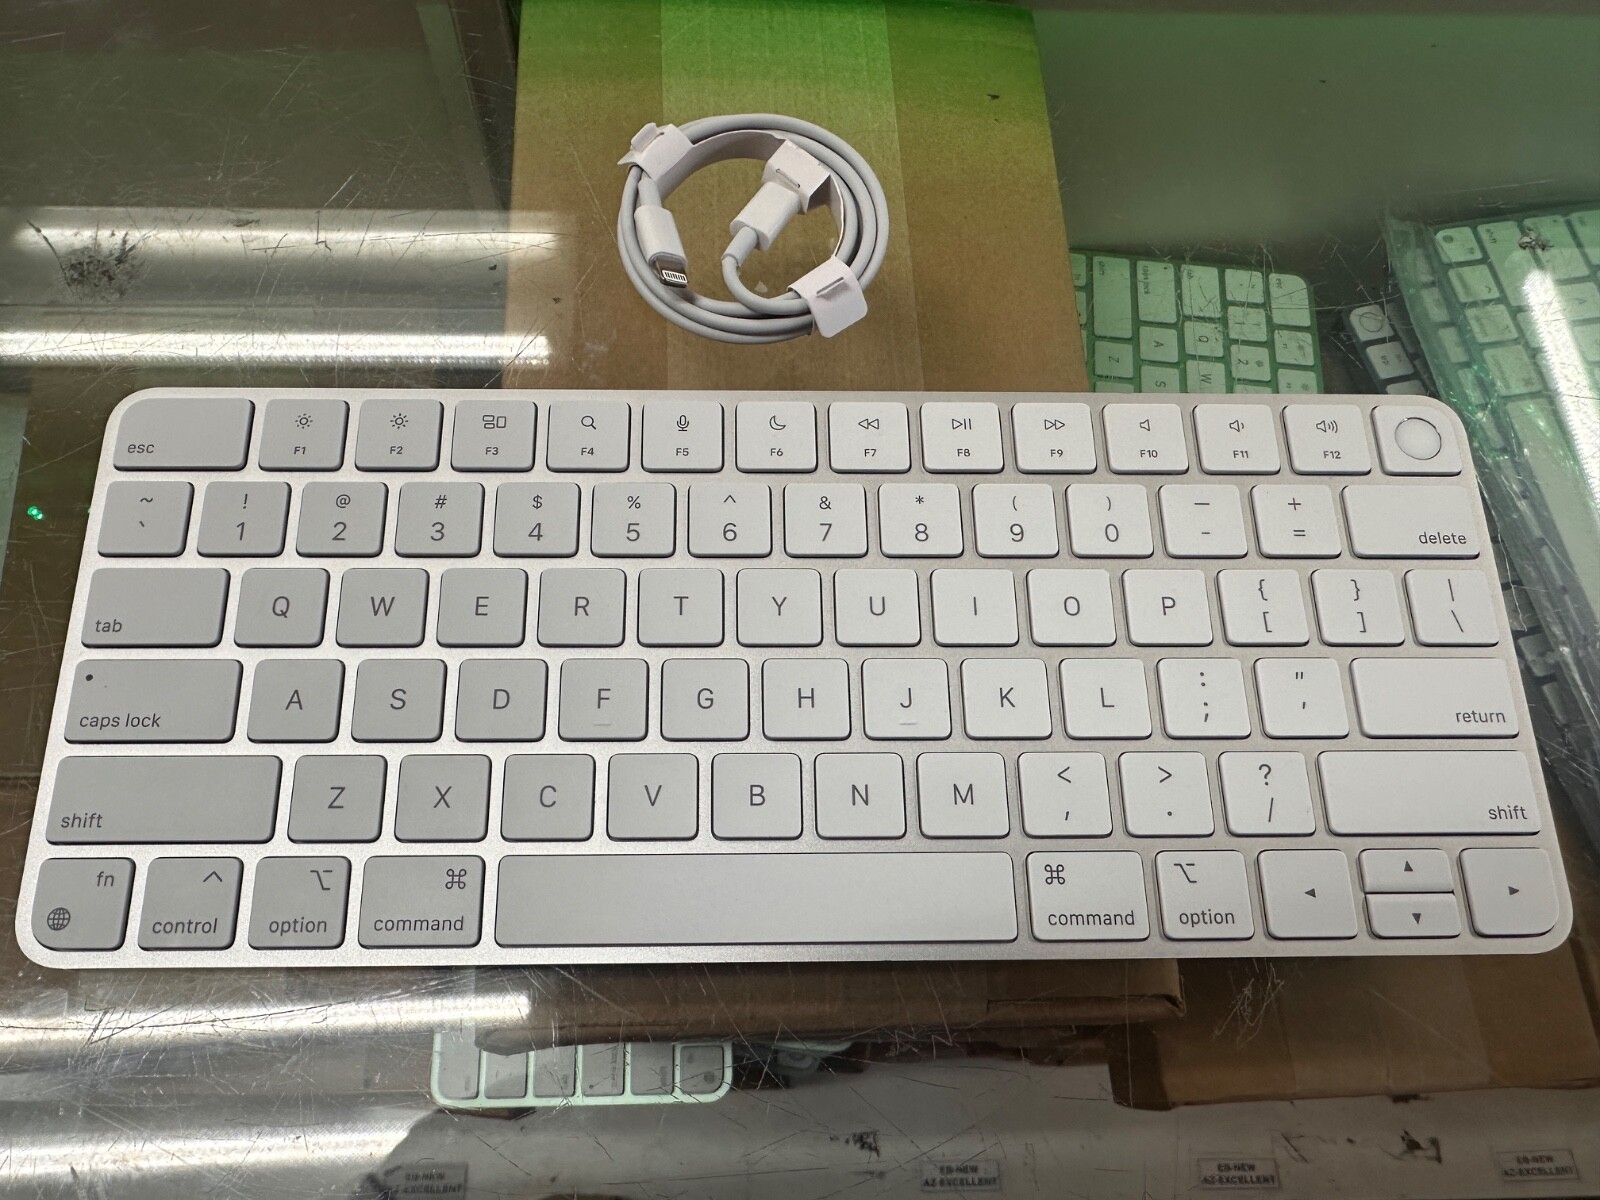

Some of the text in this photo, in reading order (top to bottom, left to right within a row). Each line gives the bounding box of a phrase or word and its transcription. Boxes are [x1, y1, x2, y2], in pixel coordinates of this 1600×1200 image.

[1107, 355, 1120, 364] Z
[1155, 380, 1167, 388] S
[1199, 373, 1212, 385] W
[127, 443, 155, 454] esc
[293, 445, 307, 455] F1
[389, 445, 404, 455] F2
[485, 446, 499, 456] F3
[580, 447, 595, 456] F4
[675, 447, 690, 457] F5
[770, 447, 784, 457] F6
[864, 448, 877, 458] F7
[956, 448, 971, 457] F8
[1050, 448, 1064, 458] F9
[1139, 449, 1158, 459] F10
[1232, 450, 1249, 459] F11
[1322, 450, 1342, 460] F12
[335, 493, 351, 509] @
[434, 494, 448, 509] #
[532, 494, 543, 510] $
[627, 495, 642, 510] %
[818, 495, 832, 510] &
[1287, 497, 1302, 511] +
[236, 521, 246, 542] 1
[331, 521, 347, 541] 2
[430, 521, 445, 542] 3
[527, 522, 544, 542] 4
[626, 522, 641, 542] 5
[722, 522, 738, 542] 6
[819, 522, 833, 542] 7
[914, 522, 930, 543] 8
[1009, 523, 1025, 543] 9
[1292, 529, 1307, 537] =
[1418, 531, 1467, 545] delete
[1257, 578, 1268, 602] {
[1350, 578, 1361, 602] }
[271, 595, 290, 619] Q
[370, 596, 396, 617] W
[474, 596, 490, 617] E
[574, 596, 590, 617] R
[673, 595, 689, 616] T
[771, 596, 788, 617] Y
[869, 595, 886, 617] U
[1063, 595, 1081, 617] O
[1161, 596, 1176, 616] P
[95, 618, 123, 633] tab
[1262, 611, 1273, 633] [
[1356, 611, 1367, 634] ]
[1450, 609, 1464, 633] \
[285, 689, 304, 711] A
[389, 688, 407, 711] S
[492, 688, 511, 710] D
[597, 688, 612, 710] F
[696, 687, 714, 710] G
[797, 687, 815, 709] H
[899, 687, 913, 709] J
[999, 686, 1016, 708] K
[1100, 687, 1115, 708] L
[79, 712, 161, 731] caps lock
[1455, 710, 1507, 724] return
[1057, 766, 1072, 784] <
[1157, 766, 1173, 784] >
[1258, 763, 1272, 786] ?
[327, 786, 346, 809] Z
[433, 785, 452, 809] X
[539, 784, 557, 809] C
[643, 784, 663, 807] V
[749, 784, 766, 807] B
[851, 783, 869, 807] N
[953, 783, 974, 806] M
[1267, 797, 1274, 823] /
[1488, 804, 1528, 820] shift
[60, 812, 103, 829] shift
[96, 870, 115, 887] fn
[151, 917, 218, 935] control
[268, 916, 327, 937] option
[373, 915, 464, 932] command
[1048, 910, 1135, 926] command
[1179, 908, 1235, 928] option
